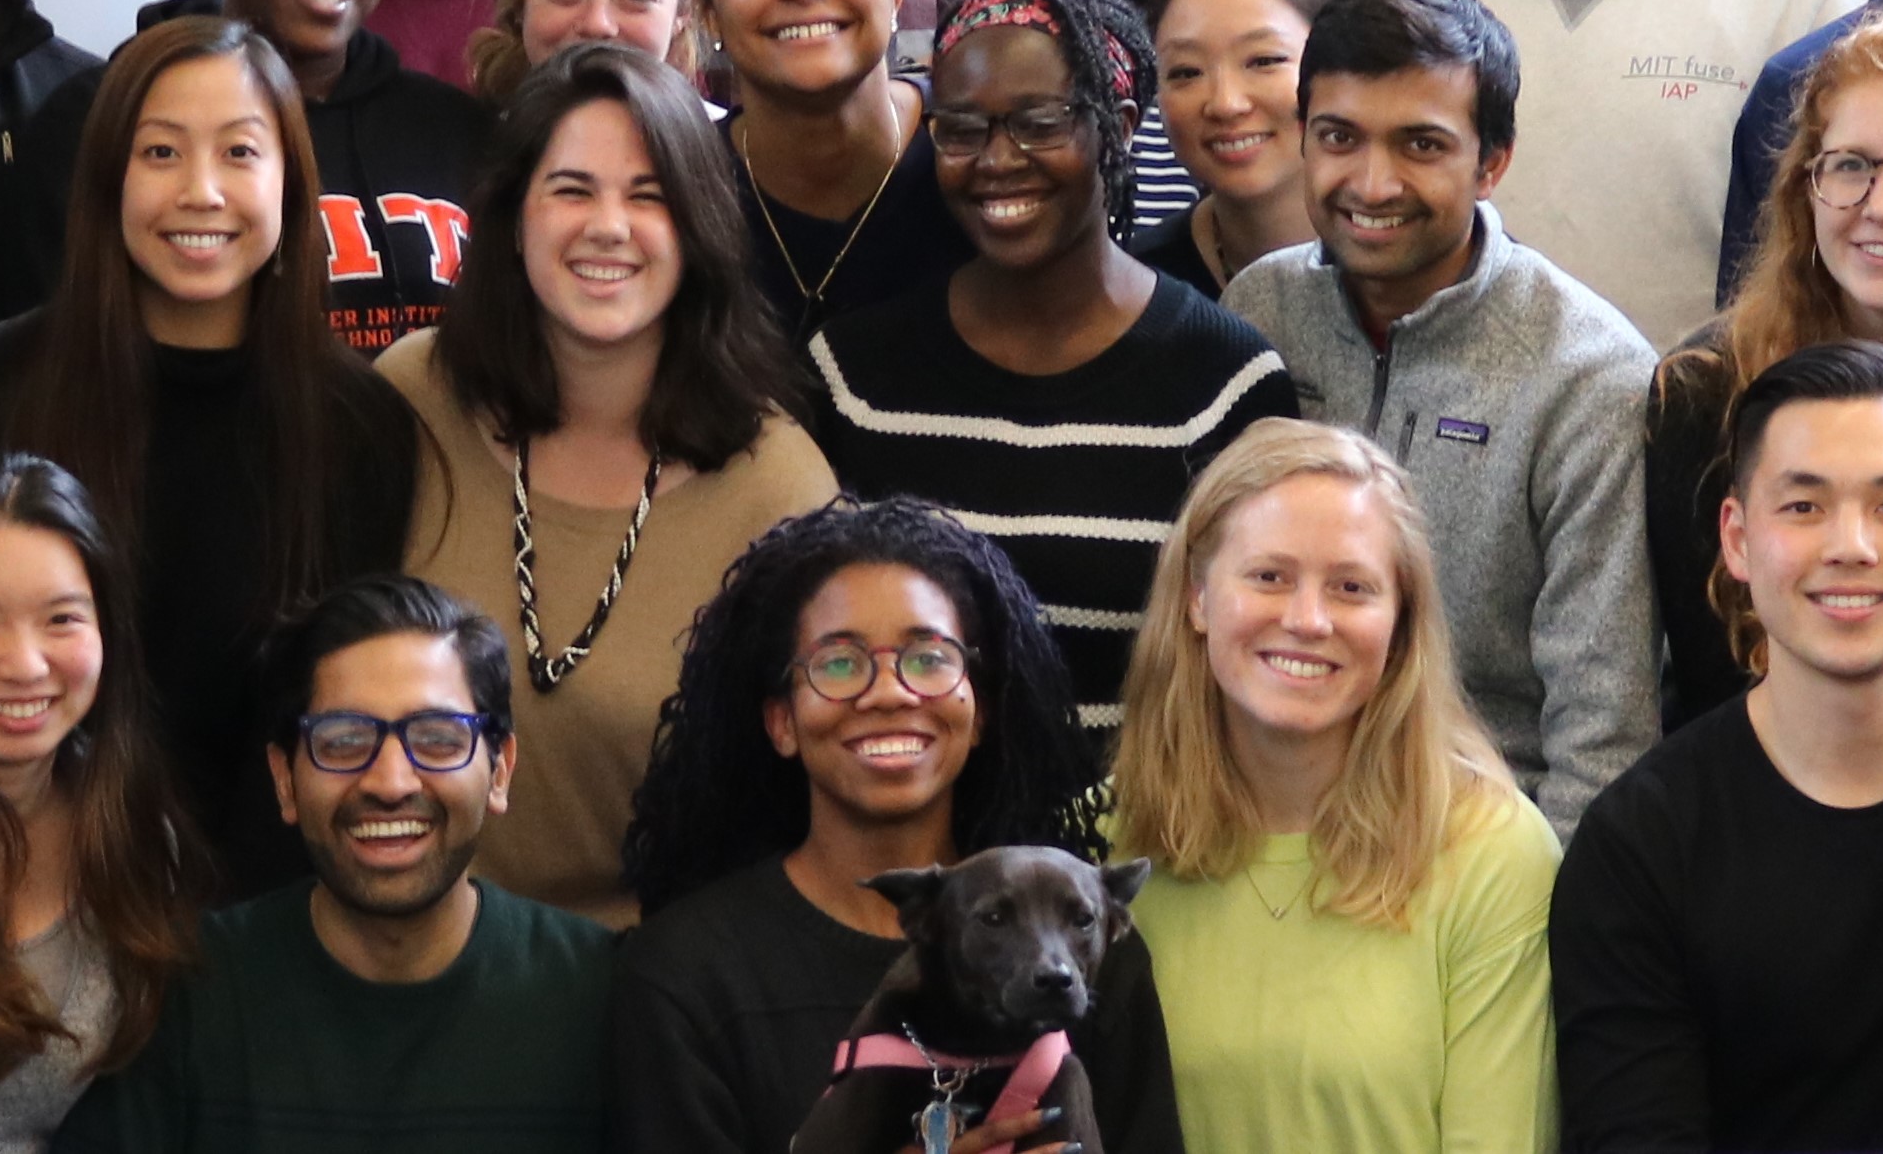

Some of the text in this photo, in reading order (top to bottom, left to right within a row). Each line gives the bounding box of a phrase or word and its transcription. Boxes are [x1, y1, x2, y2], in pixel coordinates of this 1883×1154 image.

[1629, 54, 1736, 81] MIT fuse
[1661, 80, 1699, 101] IAP
[318, 192, 472, 288] IT
[328, 310, 359, 328] ER
